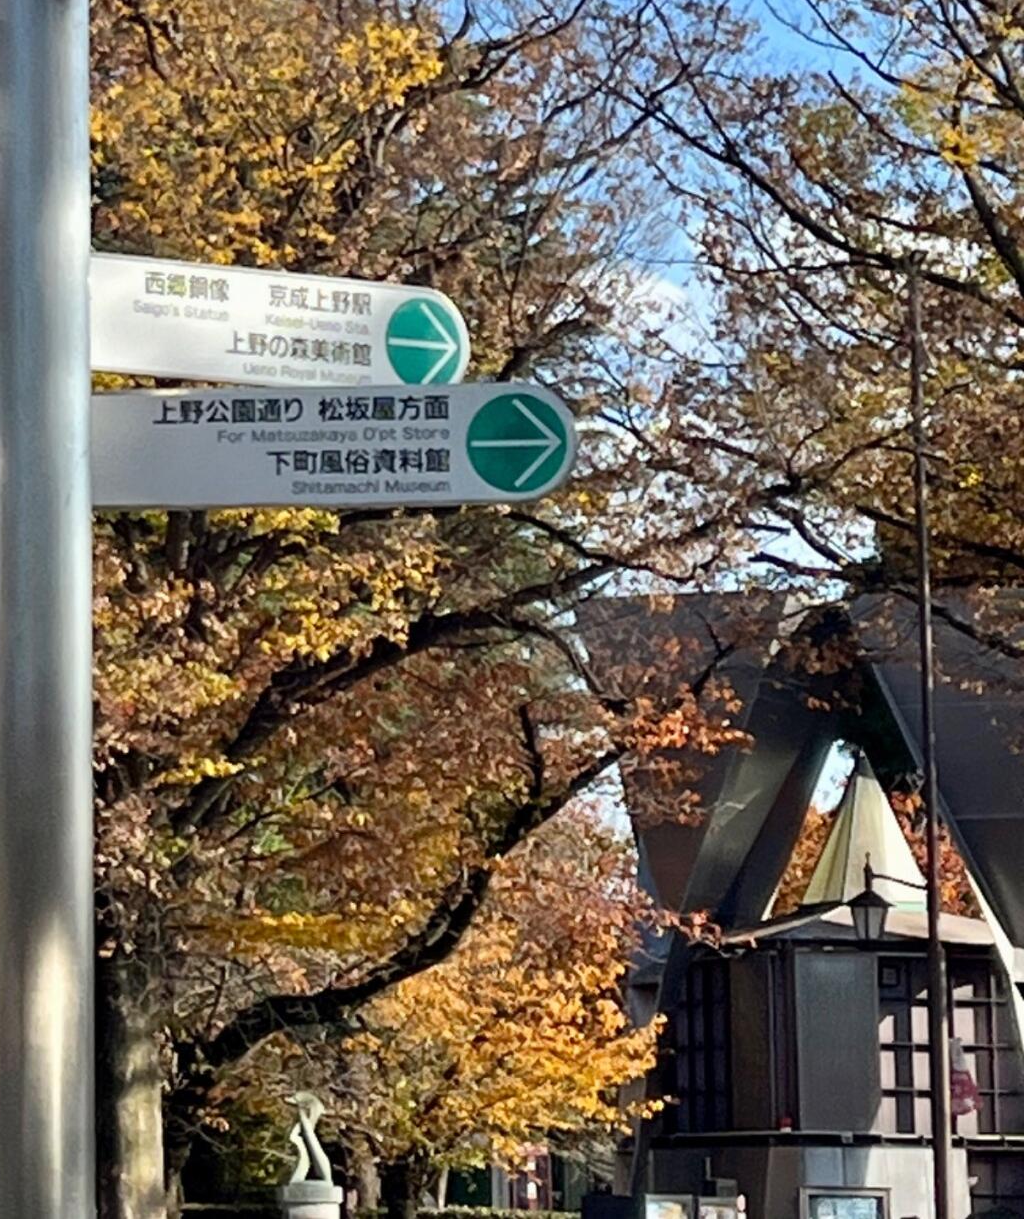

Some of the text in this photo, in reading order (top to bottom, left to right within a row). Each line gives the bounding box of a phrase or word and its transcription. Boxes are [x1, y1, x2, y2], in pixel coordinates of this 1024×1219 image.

[269, 284, 372, 316] 京成上野駅
[183, 305, 230, 322] Statue
[225, 330, 372, 367] 上野の森美術館
[243, 362, 372, 385] Ueno Royal Museum
[152, 395, 450, 424] 上野公園通り 松坂屋方面
[216, 430, 245, 443] For
[251, 429, 357, 444] Matsuzakaya
[402, 426, 450, 441] Store
[266, 448, 450, 476] 下町風俗資料館
[291, 479, 452, 496] Shitamachi Museum
